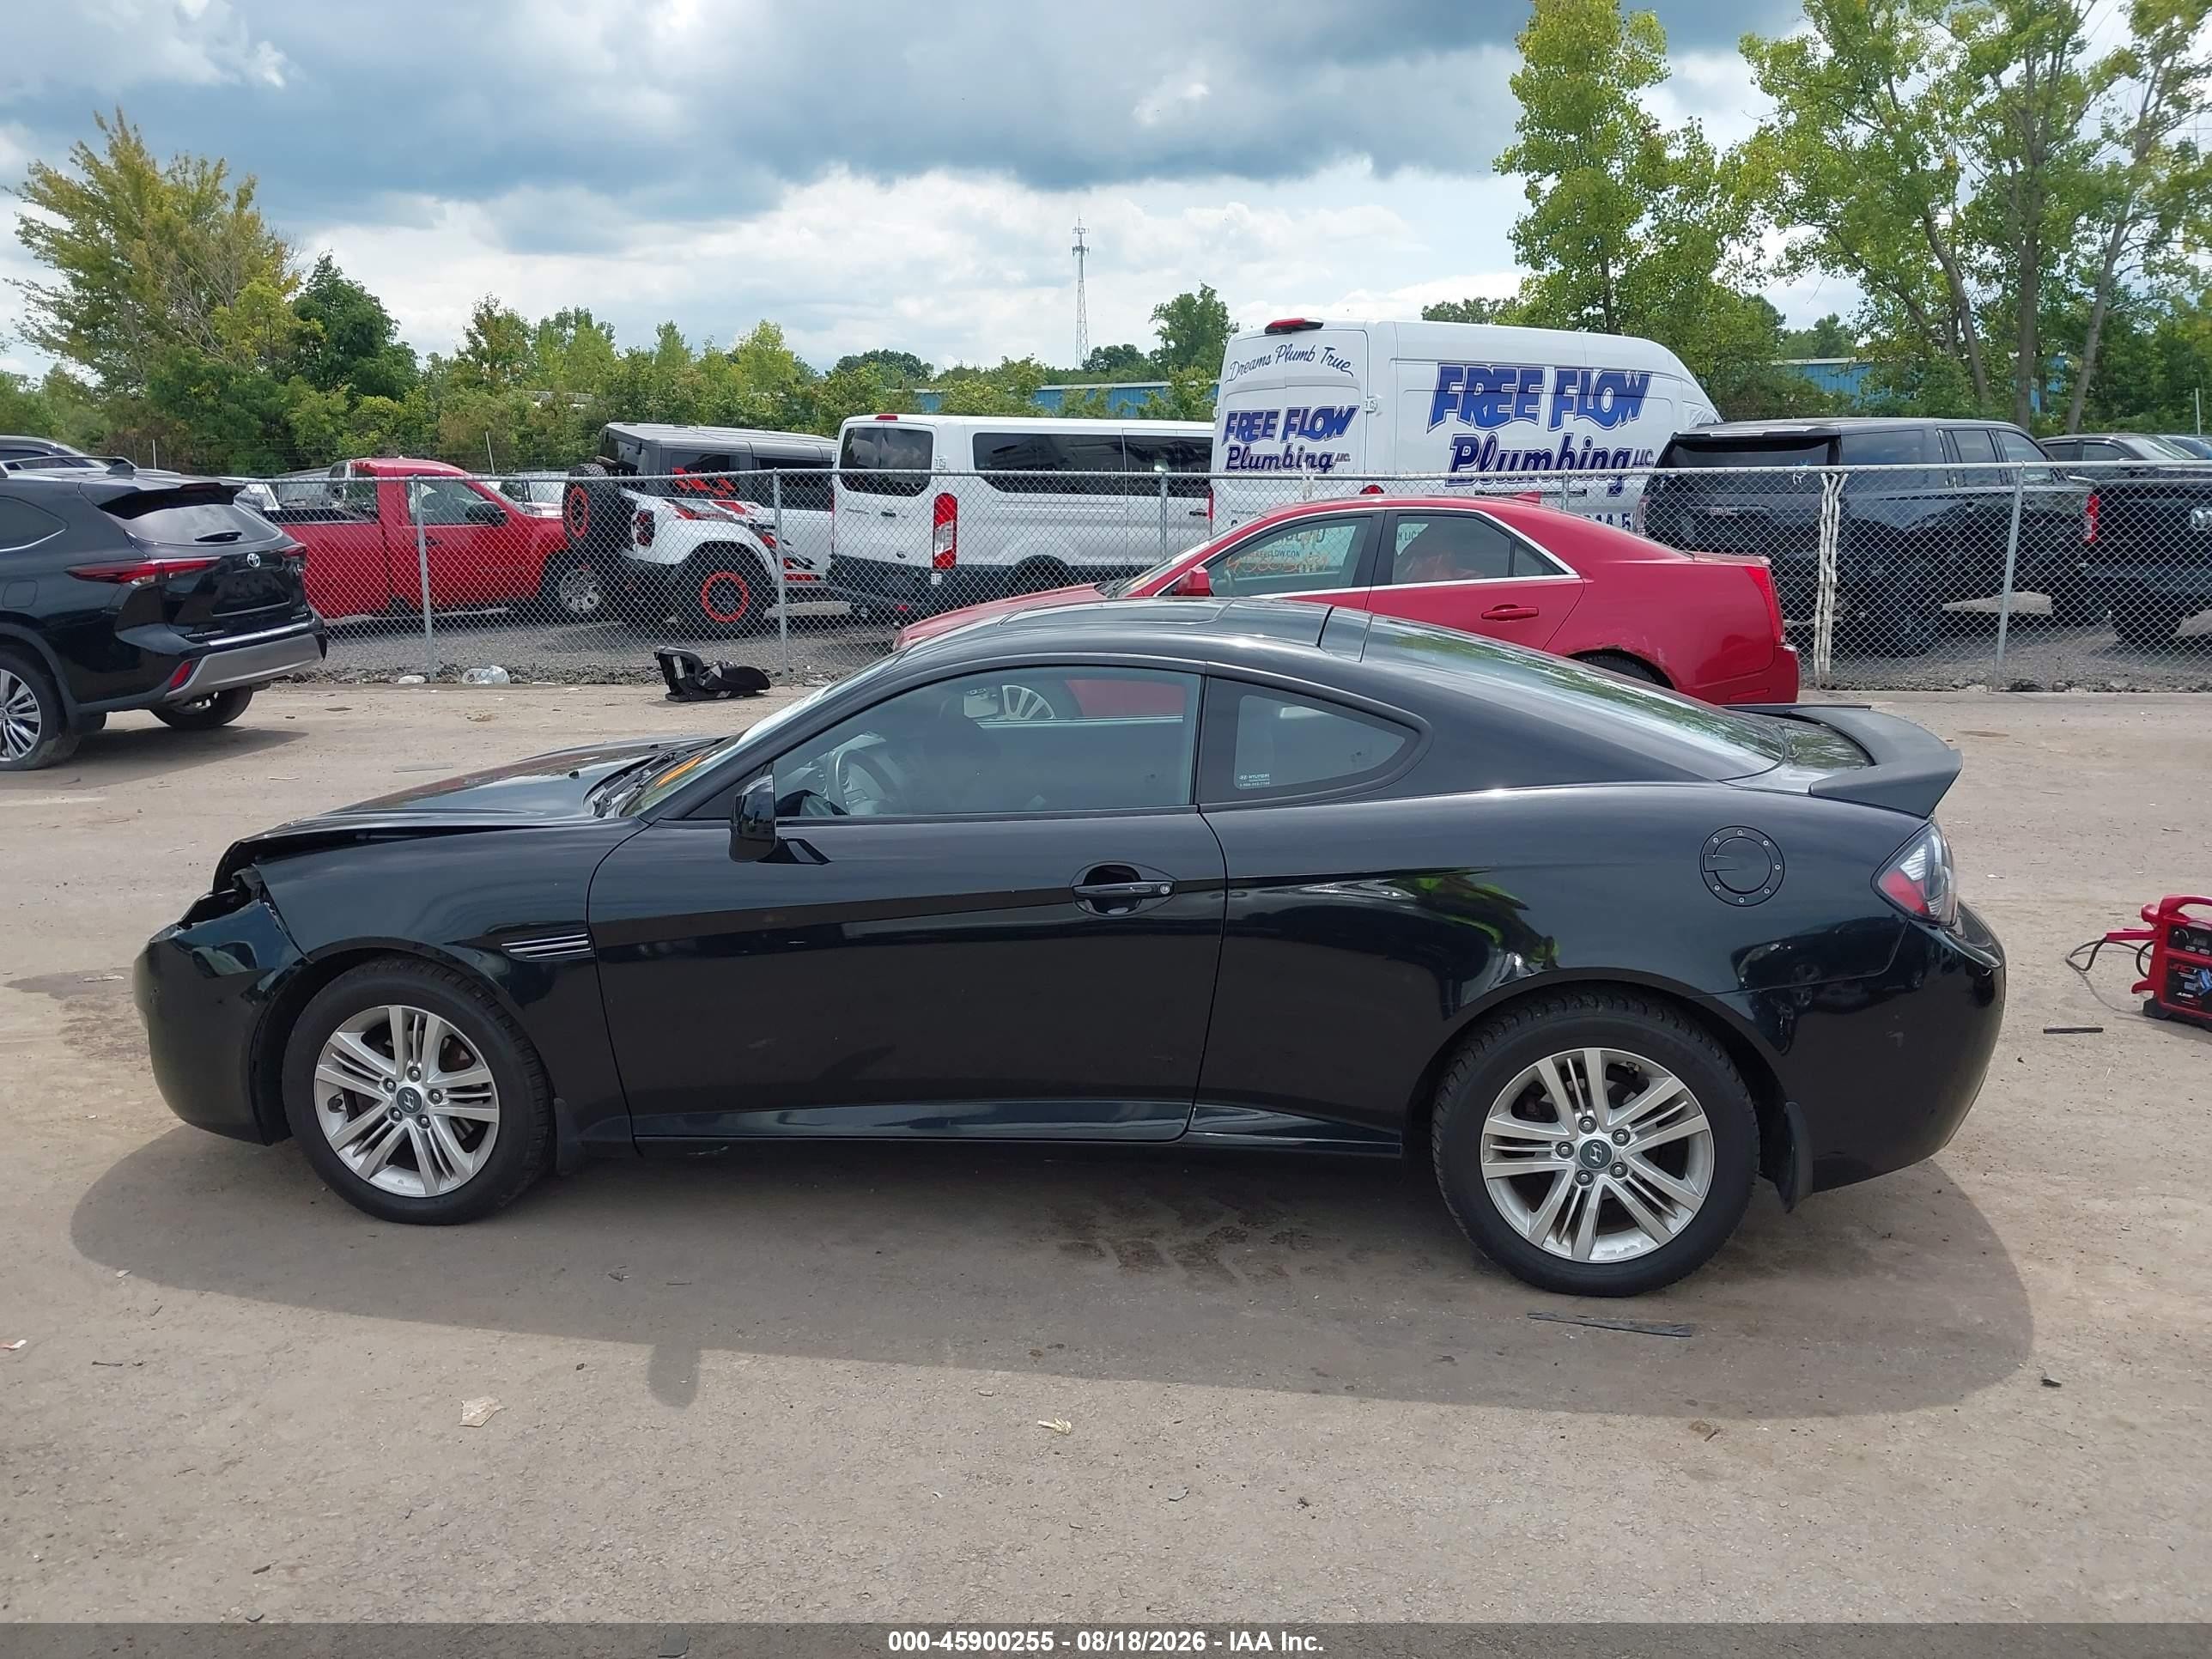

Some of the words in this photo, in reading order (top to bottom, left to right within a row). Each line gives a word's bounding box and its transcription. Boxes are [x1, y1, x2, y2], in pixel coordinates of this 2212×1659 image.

[1224, 354, 1272, 384] Dreams
[1275, 343, 1316, 364] Plumb
[1321, 347, 1354, 378] True
[1426, 362, 1545, 434] FREE
[1547, 367, 1653, 432] FLOW
[1222, 410, 1281, 447] FREE
[1279, 405, 1360, 444] FLOW
[1224, 443, 1336, 473] Plumbing
[1445, 431, 1632, 498] Plumbing
